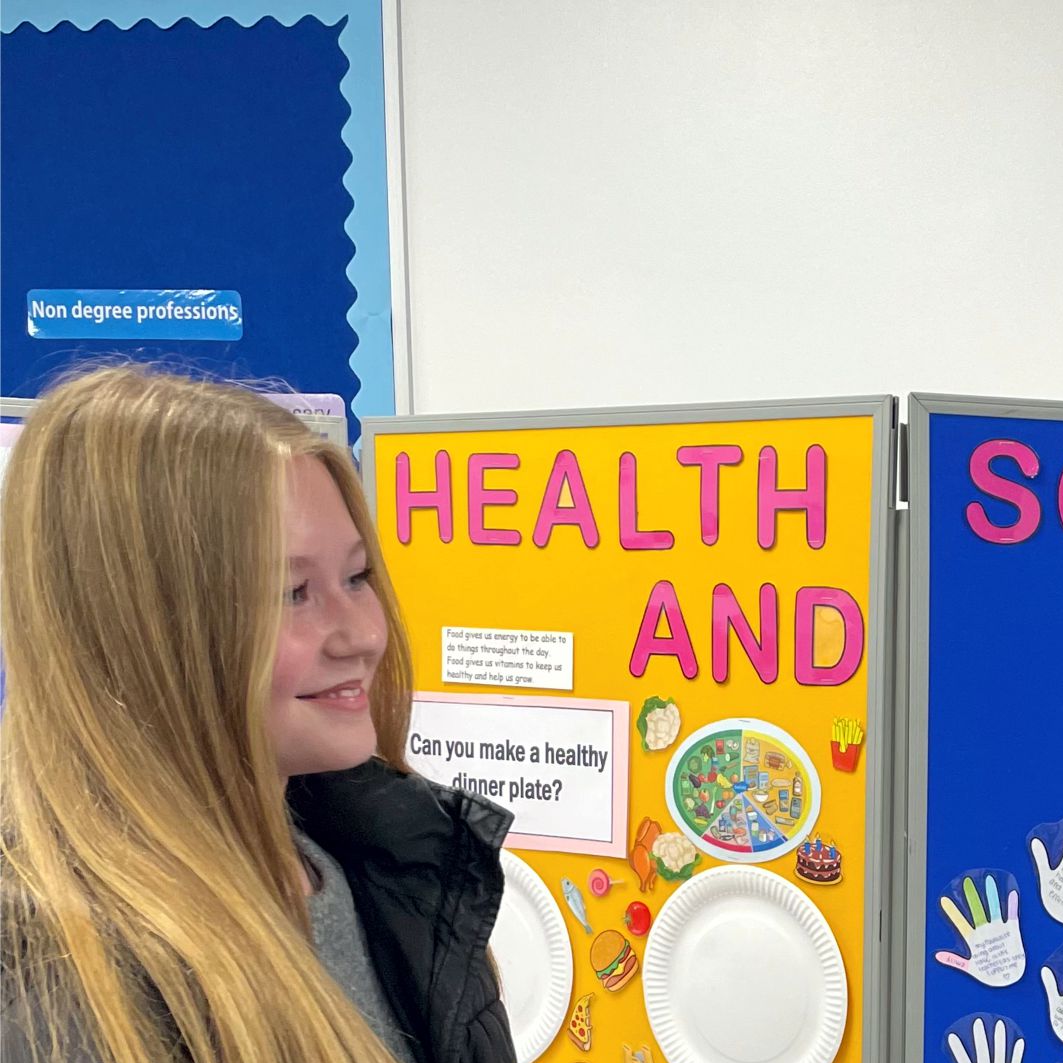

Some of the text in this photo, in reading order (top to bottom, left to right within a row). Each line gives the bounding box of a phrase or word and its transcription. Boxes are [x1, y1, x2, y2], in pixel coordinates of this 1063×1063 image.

[31, 300, 238, 324] Non degree professions
[395, 443, 829, 551] HEALTH
[446, 629, 464, 638] Food
[465, 631, 482, 641] gives
[494, 633, 518, 643] energy
[520, 634, 528, 642] to
[530, 634, 539, 642] be
[541, 635, 557, 643] able
[628, 580, 866, 687] AND
[446, 643, 456, 651] do
[458, 645, 479, 655] things
[481, 646, 520, 656] throughout
[446, 656, 464, 665] Food
[465, 659, 484, 668] gives
[494, 660, 524, 669] vitamins
[535, 661, 552, 672] keep
[446, 670, 473, 680] healthy
[474, 671, 487, 681] and
[488, 672, 504, 683] help
[410, 733, 608, 773] Can you make a healthy
[452, 772, 563, 802] dinner plate?
